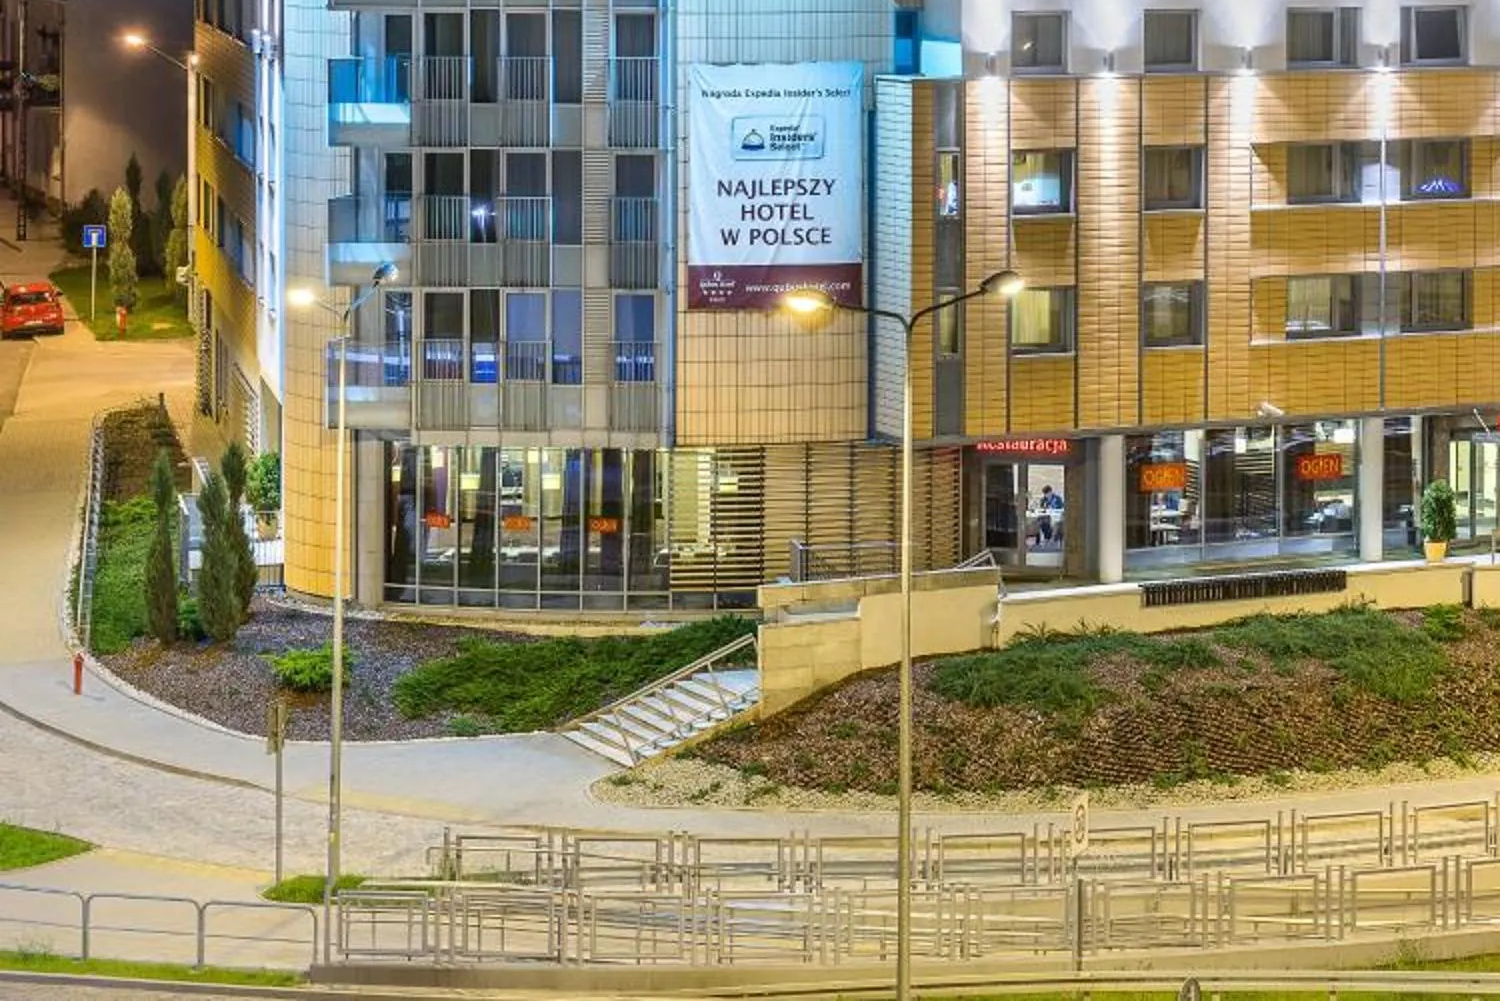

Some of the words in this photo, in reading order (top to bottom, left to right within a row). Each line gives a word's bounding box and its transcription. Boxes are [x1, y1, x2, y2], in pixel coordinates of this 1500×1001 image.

[701, 88, 742, 100] Nagroda
[745, 88, 781, 100] Expedia
[717, 178, 836, 200] NAJLEPSZY
[741, 203, 815, 222] HOTEL
[721, 228, 741, 246] W
[749, 227, 832, 246] POLSCE
